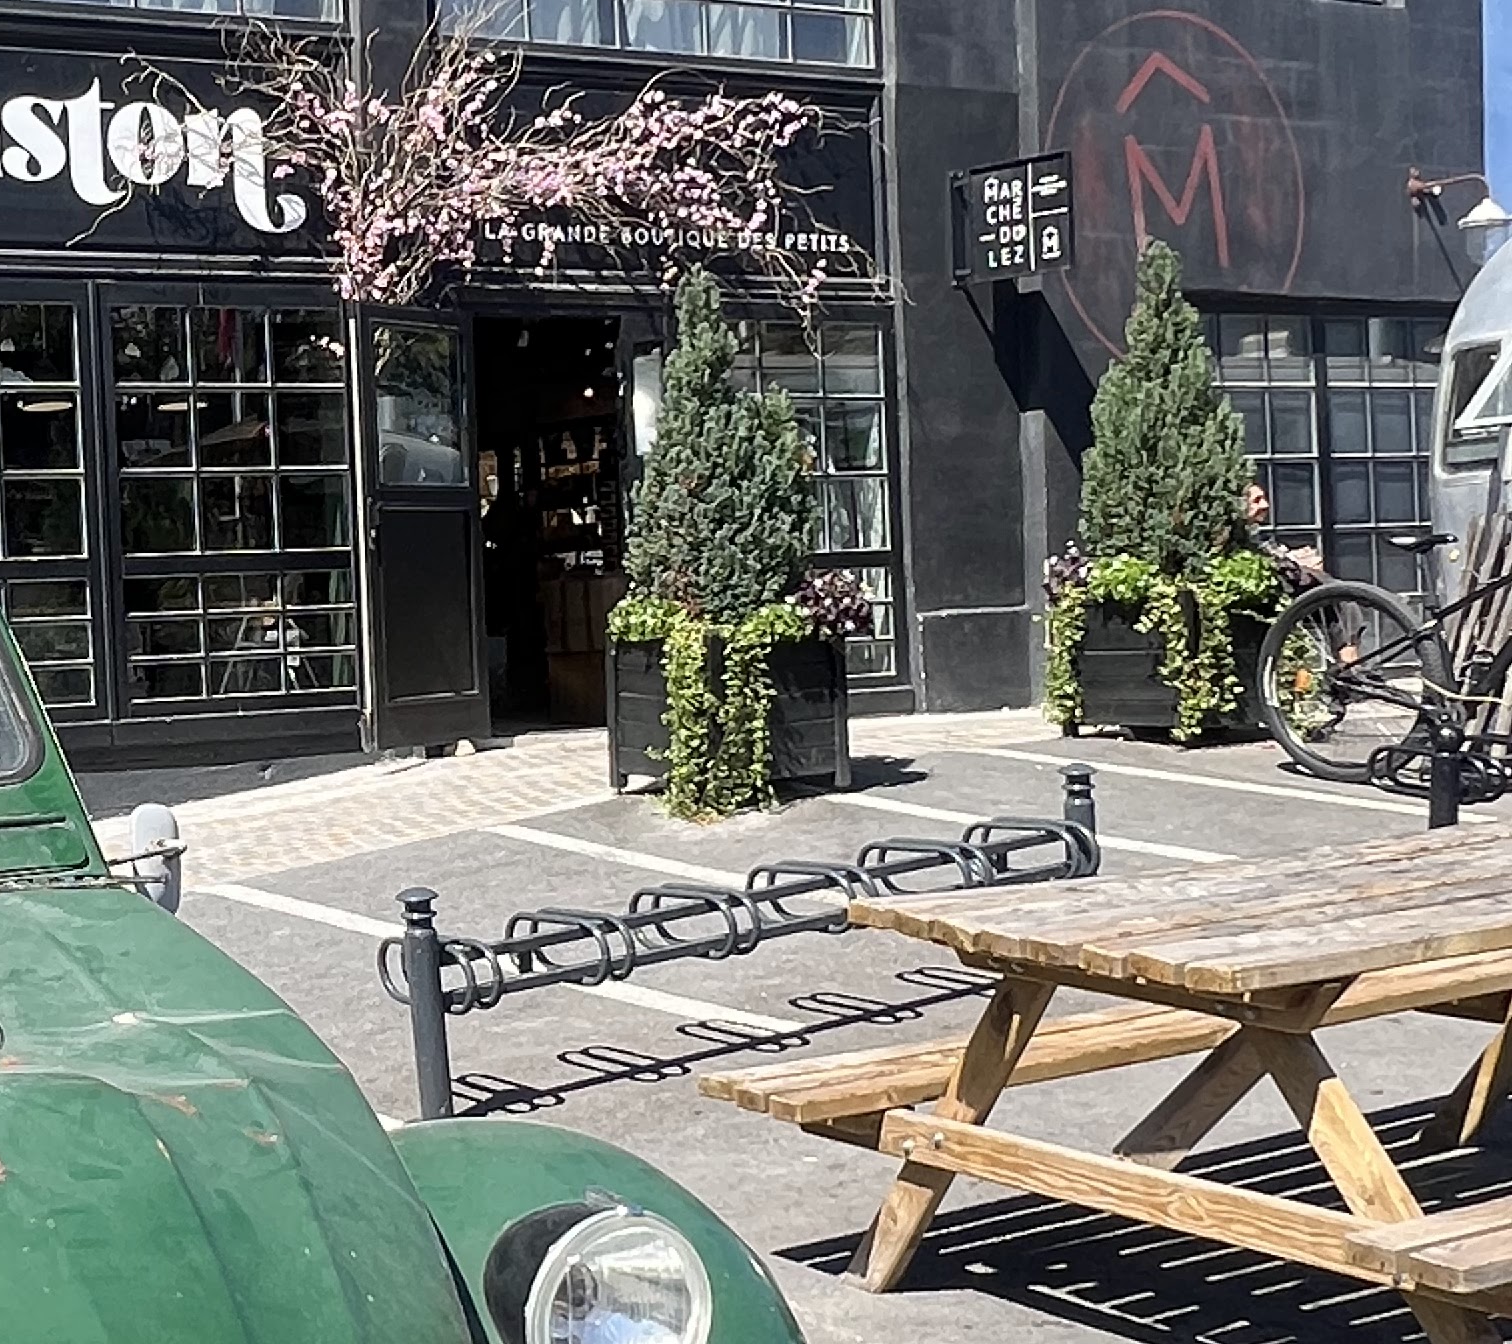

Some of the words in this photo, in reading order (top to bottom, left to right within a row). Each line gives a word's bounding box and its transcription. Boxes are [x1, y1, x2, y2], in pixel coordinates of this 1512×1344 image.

[484, 222, 517, 239] LA
[521, 223, 610, 243] GRANDE
[738, 229, 776, 250] DES
[784, 232, 850, 253] PETITS
[988, 245, 1024, 267] LEZ
